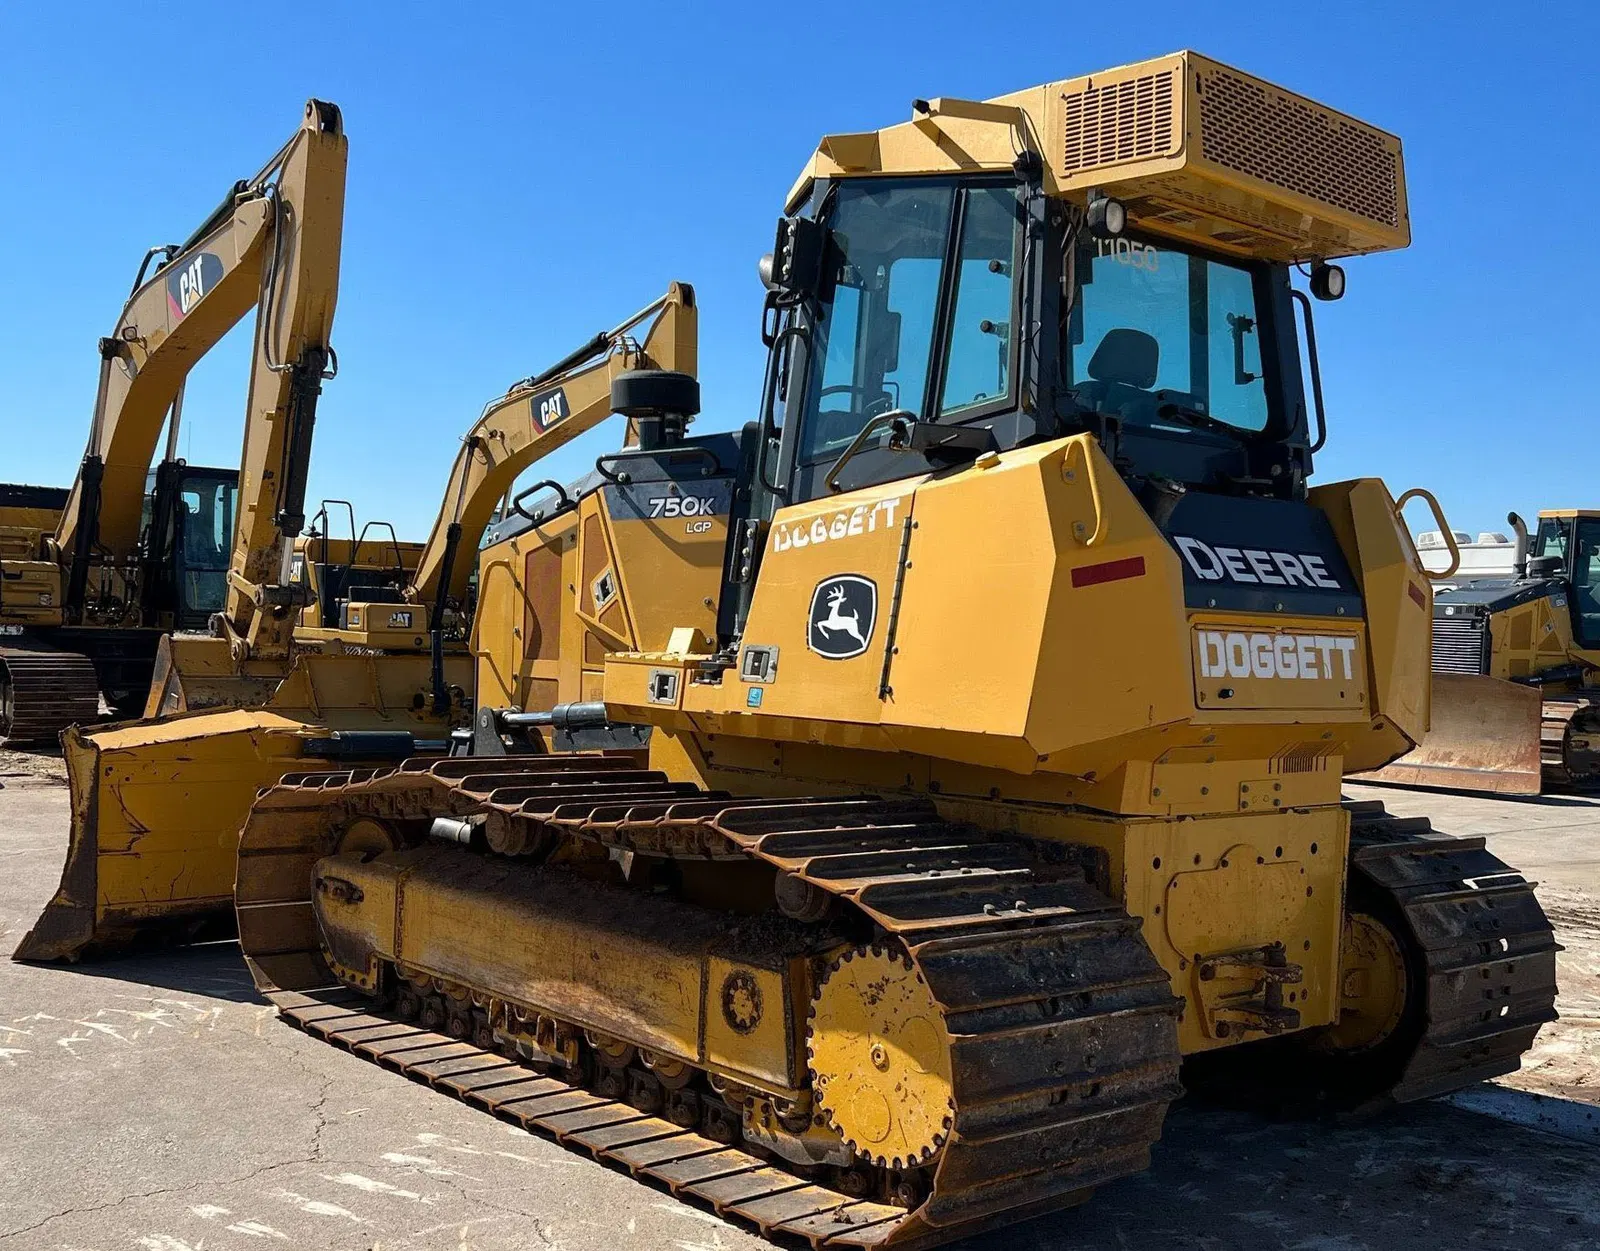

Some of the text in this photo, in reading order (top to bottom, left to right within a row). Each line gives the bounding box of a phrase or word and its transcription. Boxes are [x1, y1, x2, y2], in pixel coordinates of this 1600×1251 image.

[1092, 236, 1158, 272] 11050
[180, 254, 203, 313] CAT
[541, 392, 561, 426] CAT
[648, 496, 716, 519] 750K
[685, 521, 712, 534] LGP
[1173, 535, 1341, 589] DEERE
[1198, 631, 1355, 680] DOGGETT
